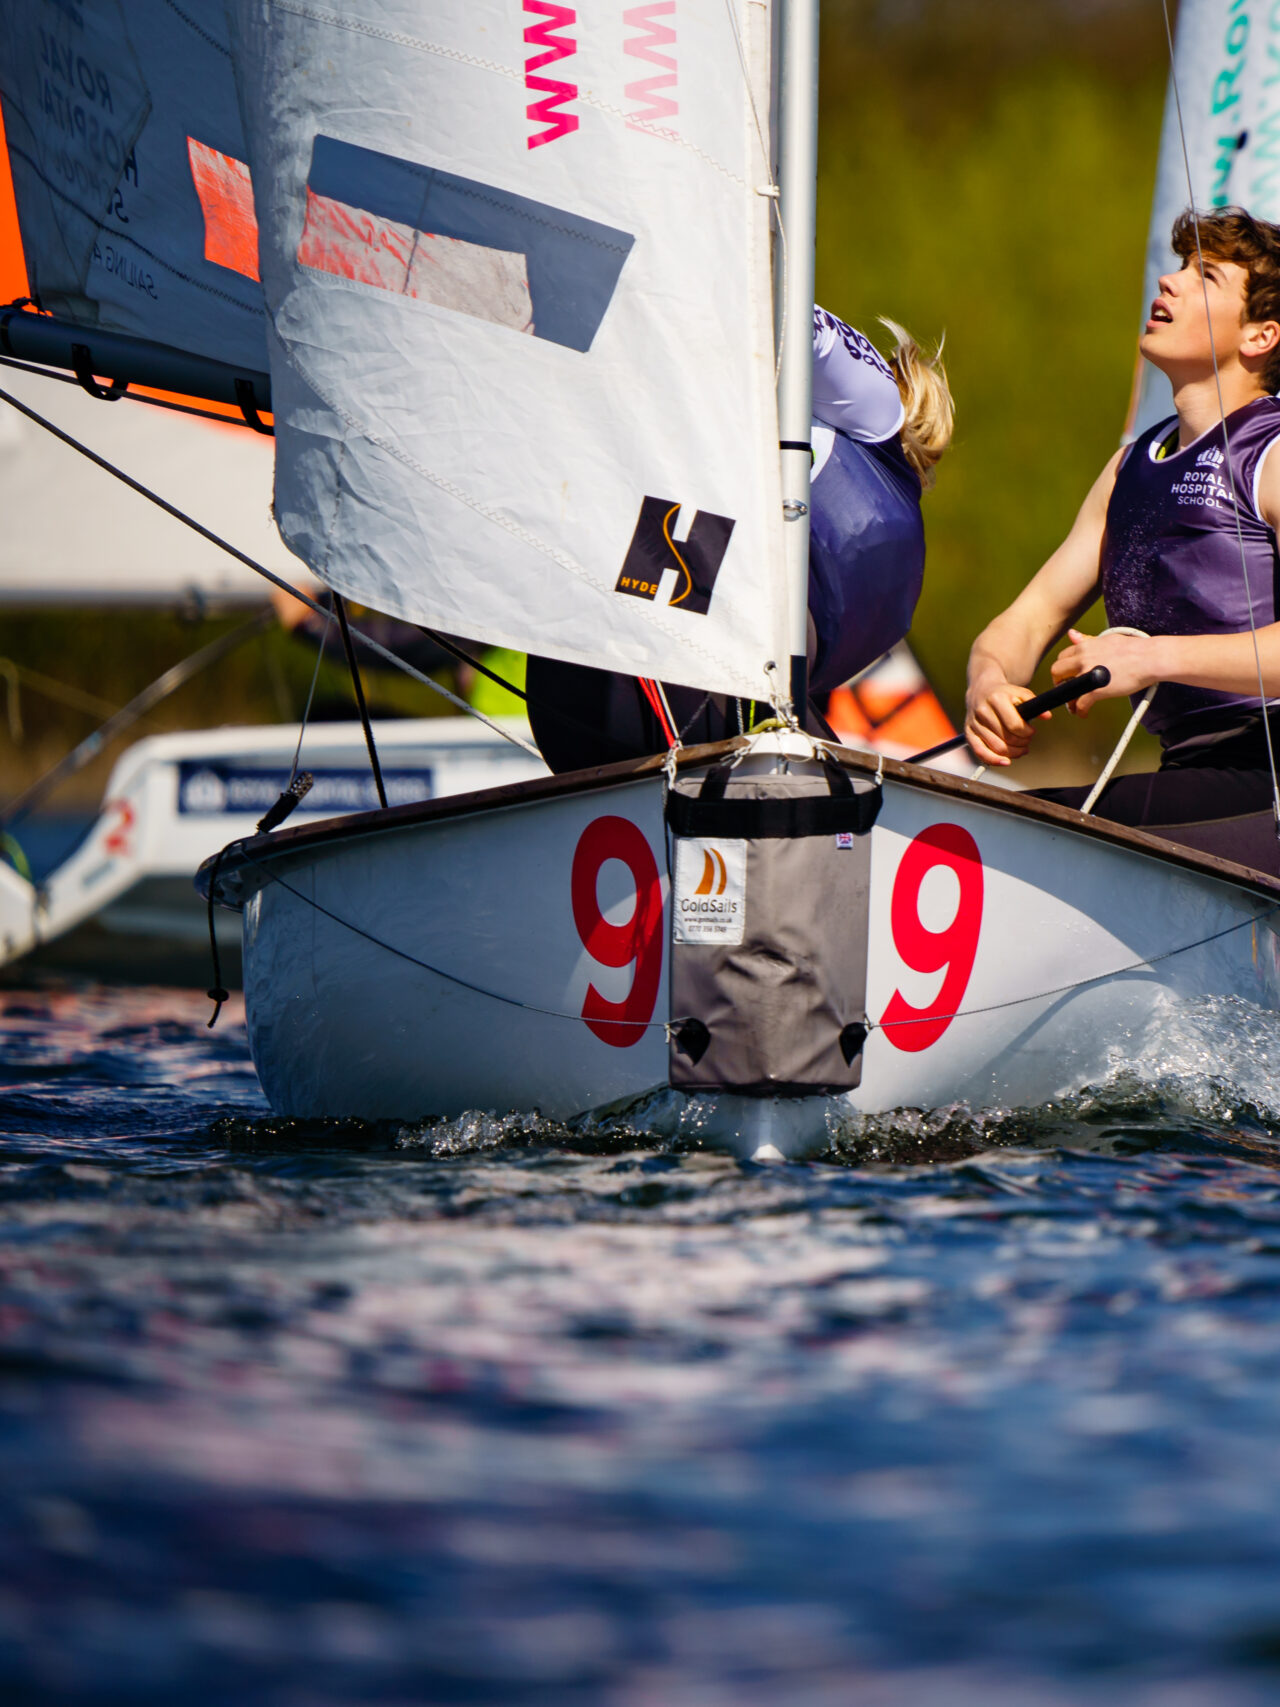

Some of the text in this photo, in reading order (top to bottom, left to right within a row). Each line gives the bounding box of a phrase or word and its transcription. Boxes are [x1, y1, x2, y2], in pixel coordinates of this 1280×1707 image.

[1183, 471, 1226, 488] ROYAL
[1170, 483, 1235, 502] HOSPITAL
[1177, 495, 1223, 509] SCHOOL
[620, 576, 659, 596] HYDE
[681, 898, 737, 913] GoldSails
[571, 815, 663, 1049] 9
[879, 822, 985, 1053] 9
